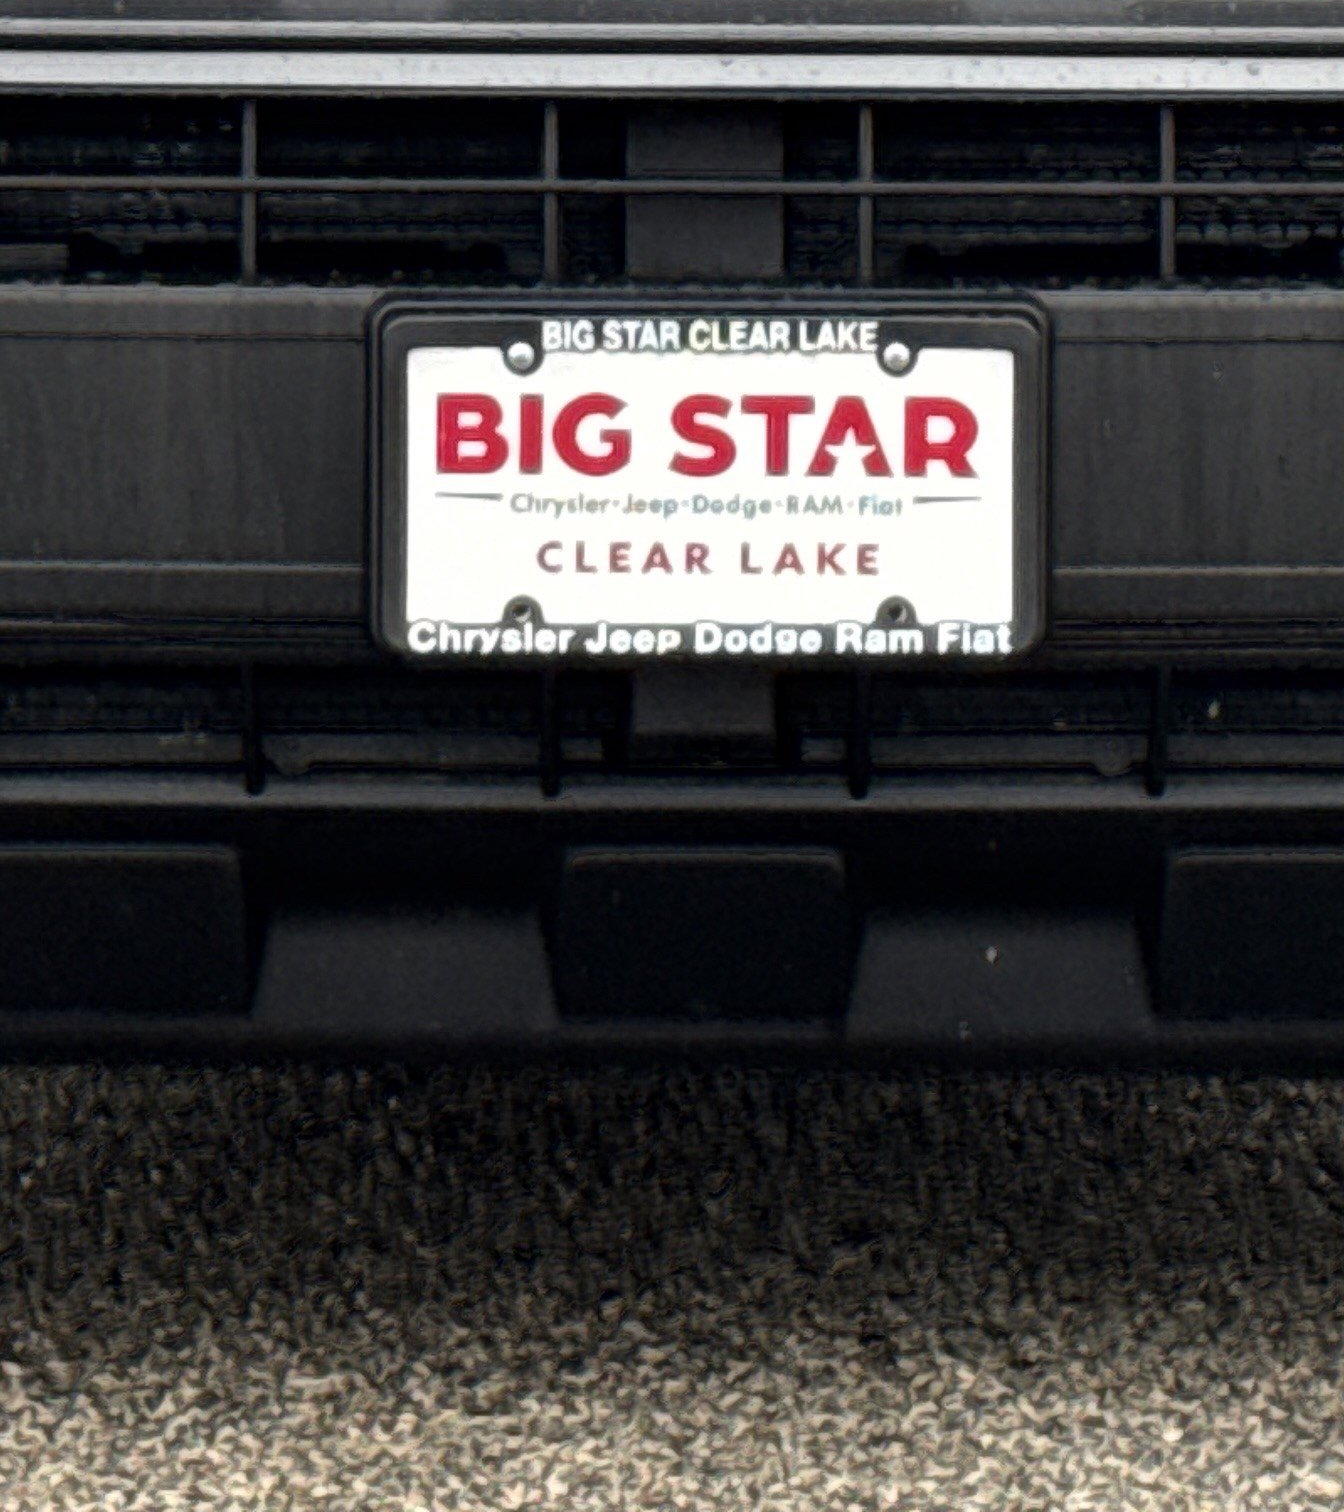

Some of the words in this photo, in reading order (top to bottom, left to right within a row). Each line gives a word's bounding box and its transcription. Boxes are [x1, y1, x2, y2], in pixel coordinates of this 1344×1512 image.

[541, 320, 596, 351] BIG
[603, 320, 680, 351] STAR
[688, 319, 791, 352] CLEAR
[798, 320, 879, 351] LAKE
[436, 392, 632, 477] BIG
[667, 393, 979, 479] STAR
[536, 540, 713, 575] CLEAR
[740, 541, 880, 576] LAKE
[407, 620, 576, 655] Chrysler
[584, 620, 683, 656] Jeep
[693, 621, 824, 655] Dodge
[835, 621, 924, 655] Ram
[937, 622, 1013, 655] Fiat
